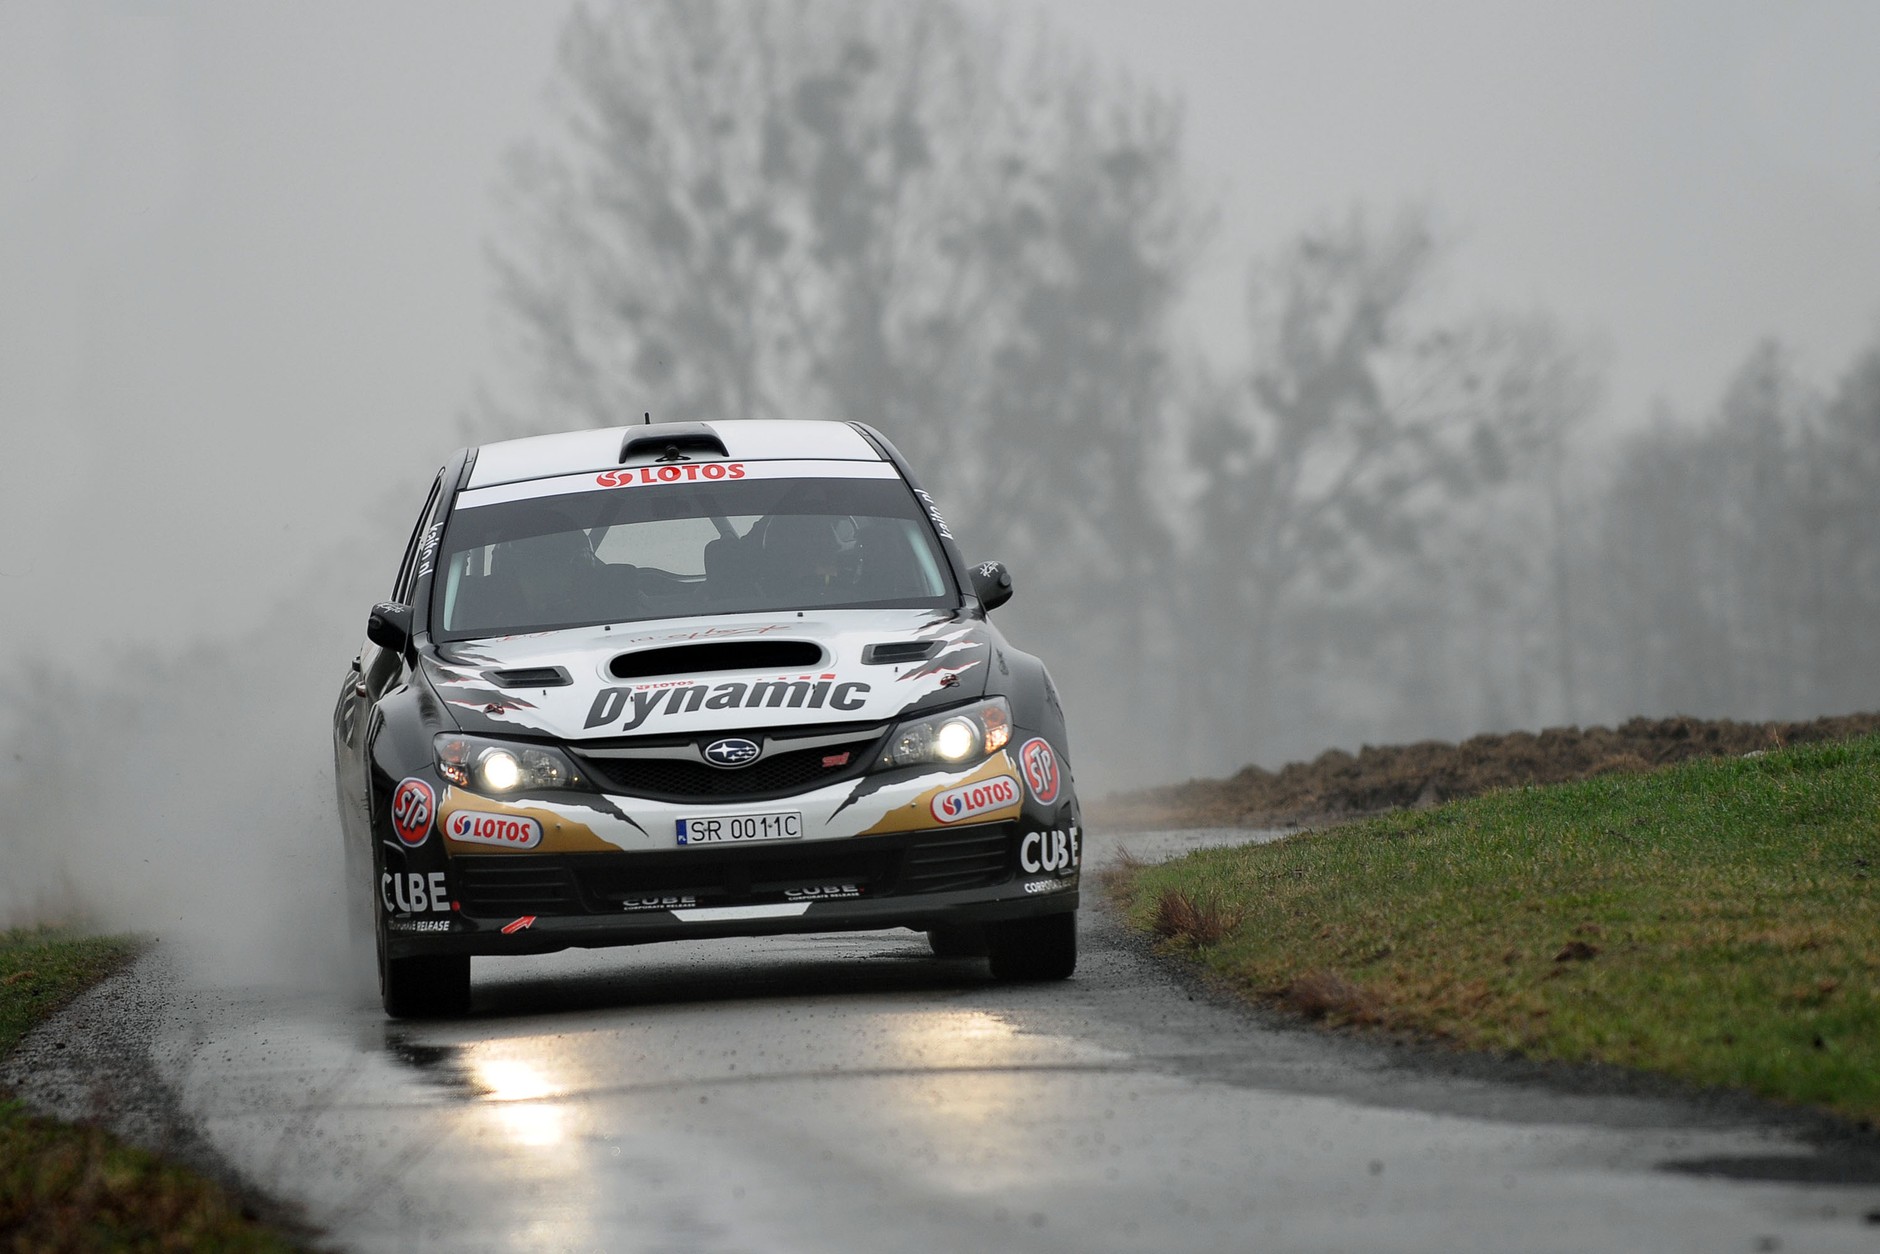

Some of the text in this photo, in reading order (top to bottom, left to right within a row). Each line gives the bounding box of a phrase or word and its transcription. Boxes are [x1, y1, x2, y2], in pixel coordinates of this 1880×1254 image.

[640, 463, 746, 484] LOTOS
[653, 680, 694, 689] LOTOS
[583, 673, 871, 732] Dynamic
[1030, 745, 1052, 794] STP
[395, 788, 428, 831] STP
[963, 781, 1013, 811] LOTOS
[473, 817, 531, 843] LOTOS
[691, 815, 798, 842] SR 0011C
